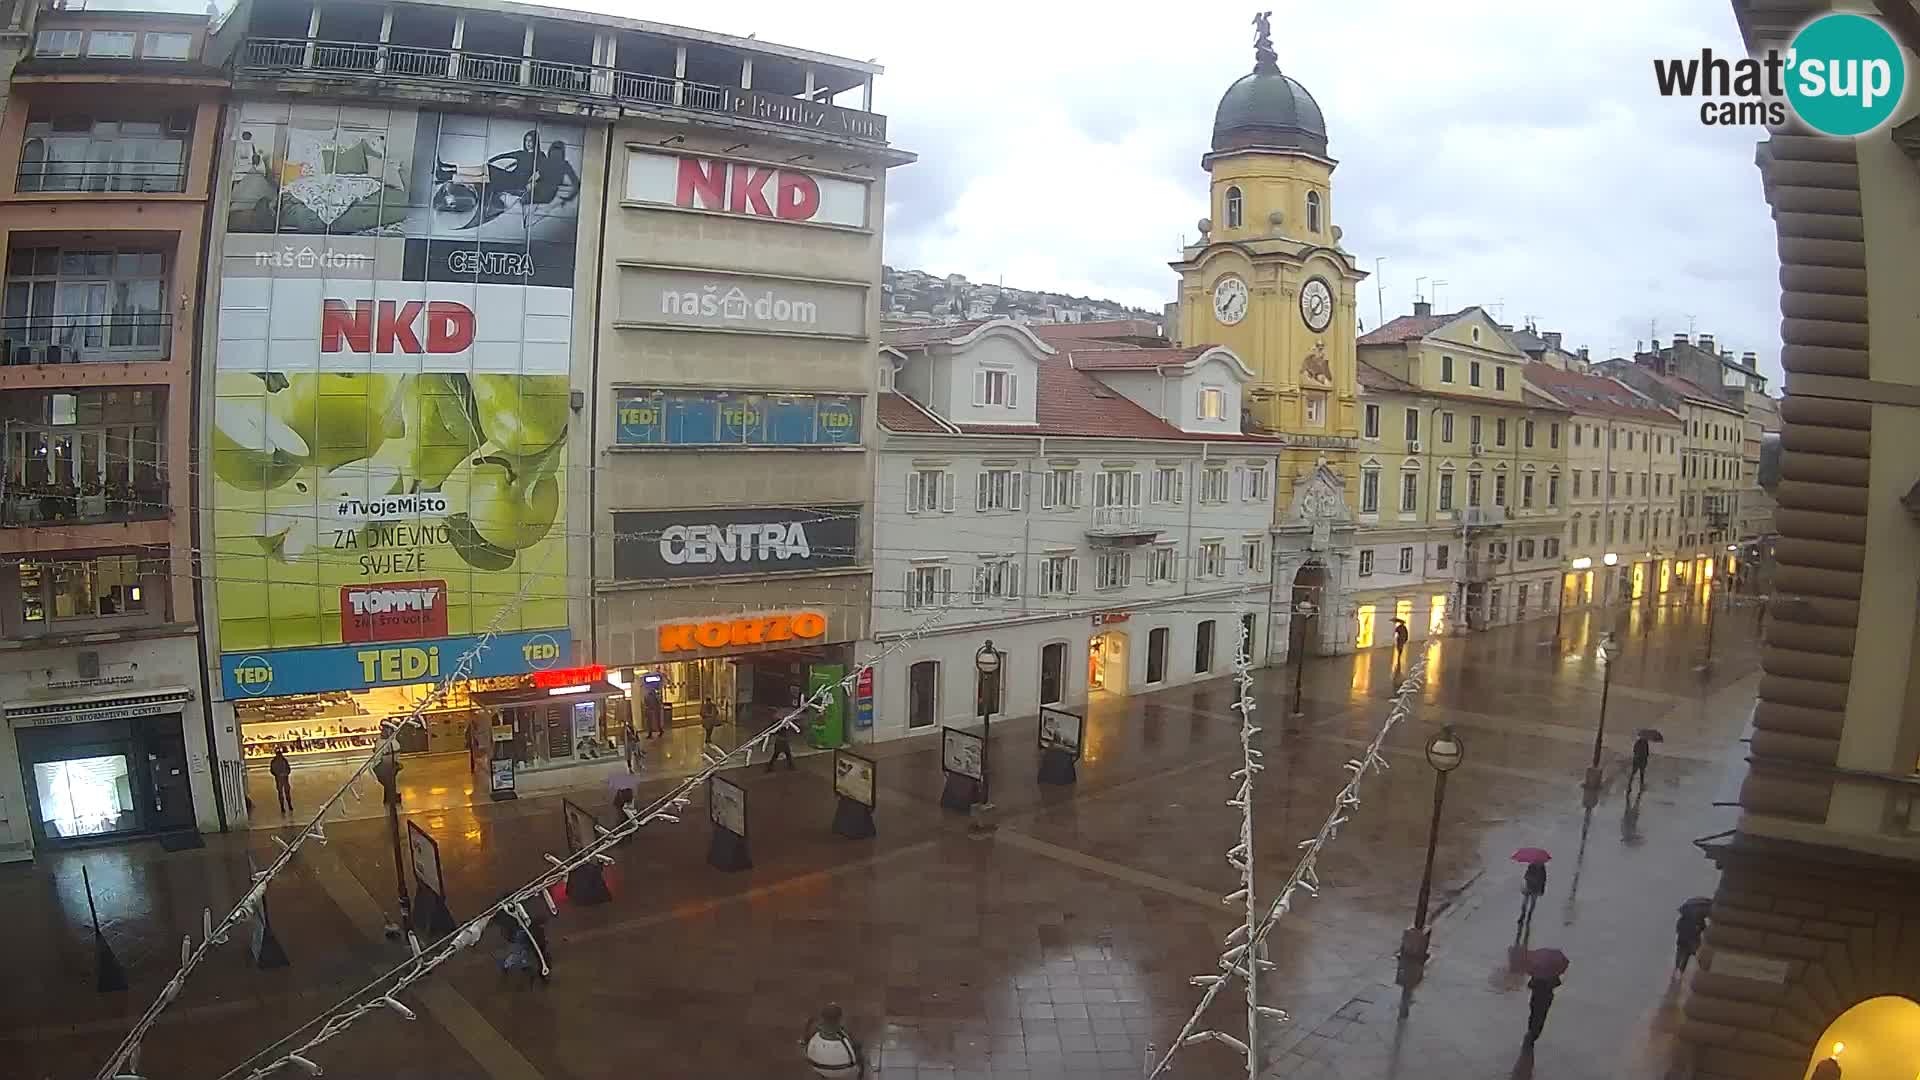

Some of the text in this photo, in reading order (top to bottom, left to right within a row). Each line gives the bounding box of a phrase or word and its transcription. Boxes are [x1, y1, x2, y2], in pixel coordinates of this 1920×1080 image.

[676, 158, 821, 221] NKD
[254, 247, 367, 270] naš dom
[447, 250, 534, 276] CENTRA
[661, 284, 817, 324] naš dom
[320, 298, 478, 355] NKD
[618, 408, 660, 426] TEDi
[338, 497, 446, 517] #TvojeMisto
[334, 524, 450, 549] ZA DNEVNO
[659, 521, 811, 565] CENTRA
[359, 546, 427, 576] SVJEŽE
[348, 587, 439, 615] TOMMY
[659, 612, 826, 653] KORZO
[358, 647, 440, 683] TEDi
[522, 644, 560, 660] TEDi
[233, 666, 273, 684] TEDi
